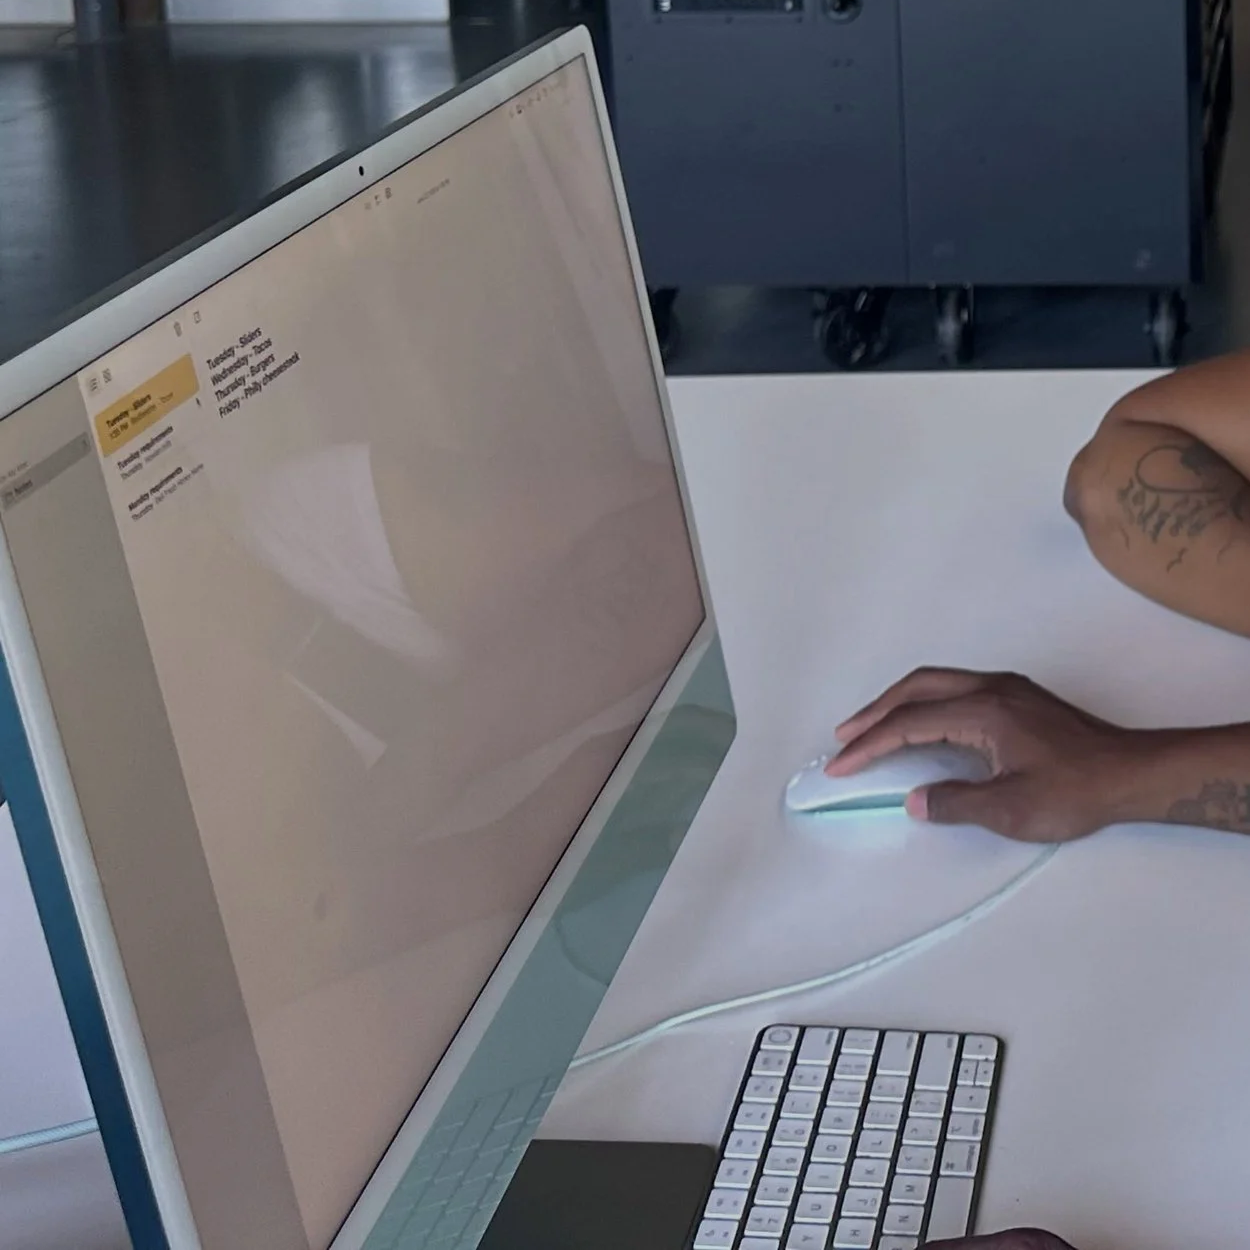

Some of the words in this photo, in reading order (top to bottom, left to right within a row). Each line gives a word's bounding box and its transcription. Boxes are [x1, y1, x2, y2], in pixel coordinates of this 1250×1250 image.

[206, 346, 235, 370] Tuesday
[239, 327, 262, 348] Sliders
[211, 354, 249, 386] Wednesday
[252, 338, 272, 355] Tacos
[215, 375, 246, 402] Thursday
[250, 353, 275, 377] Burgers
[219, 396, 240, 419] Friday
